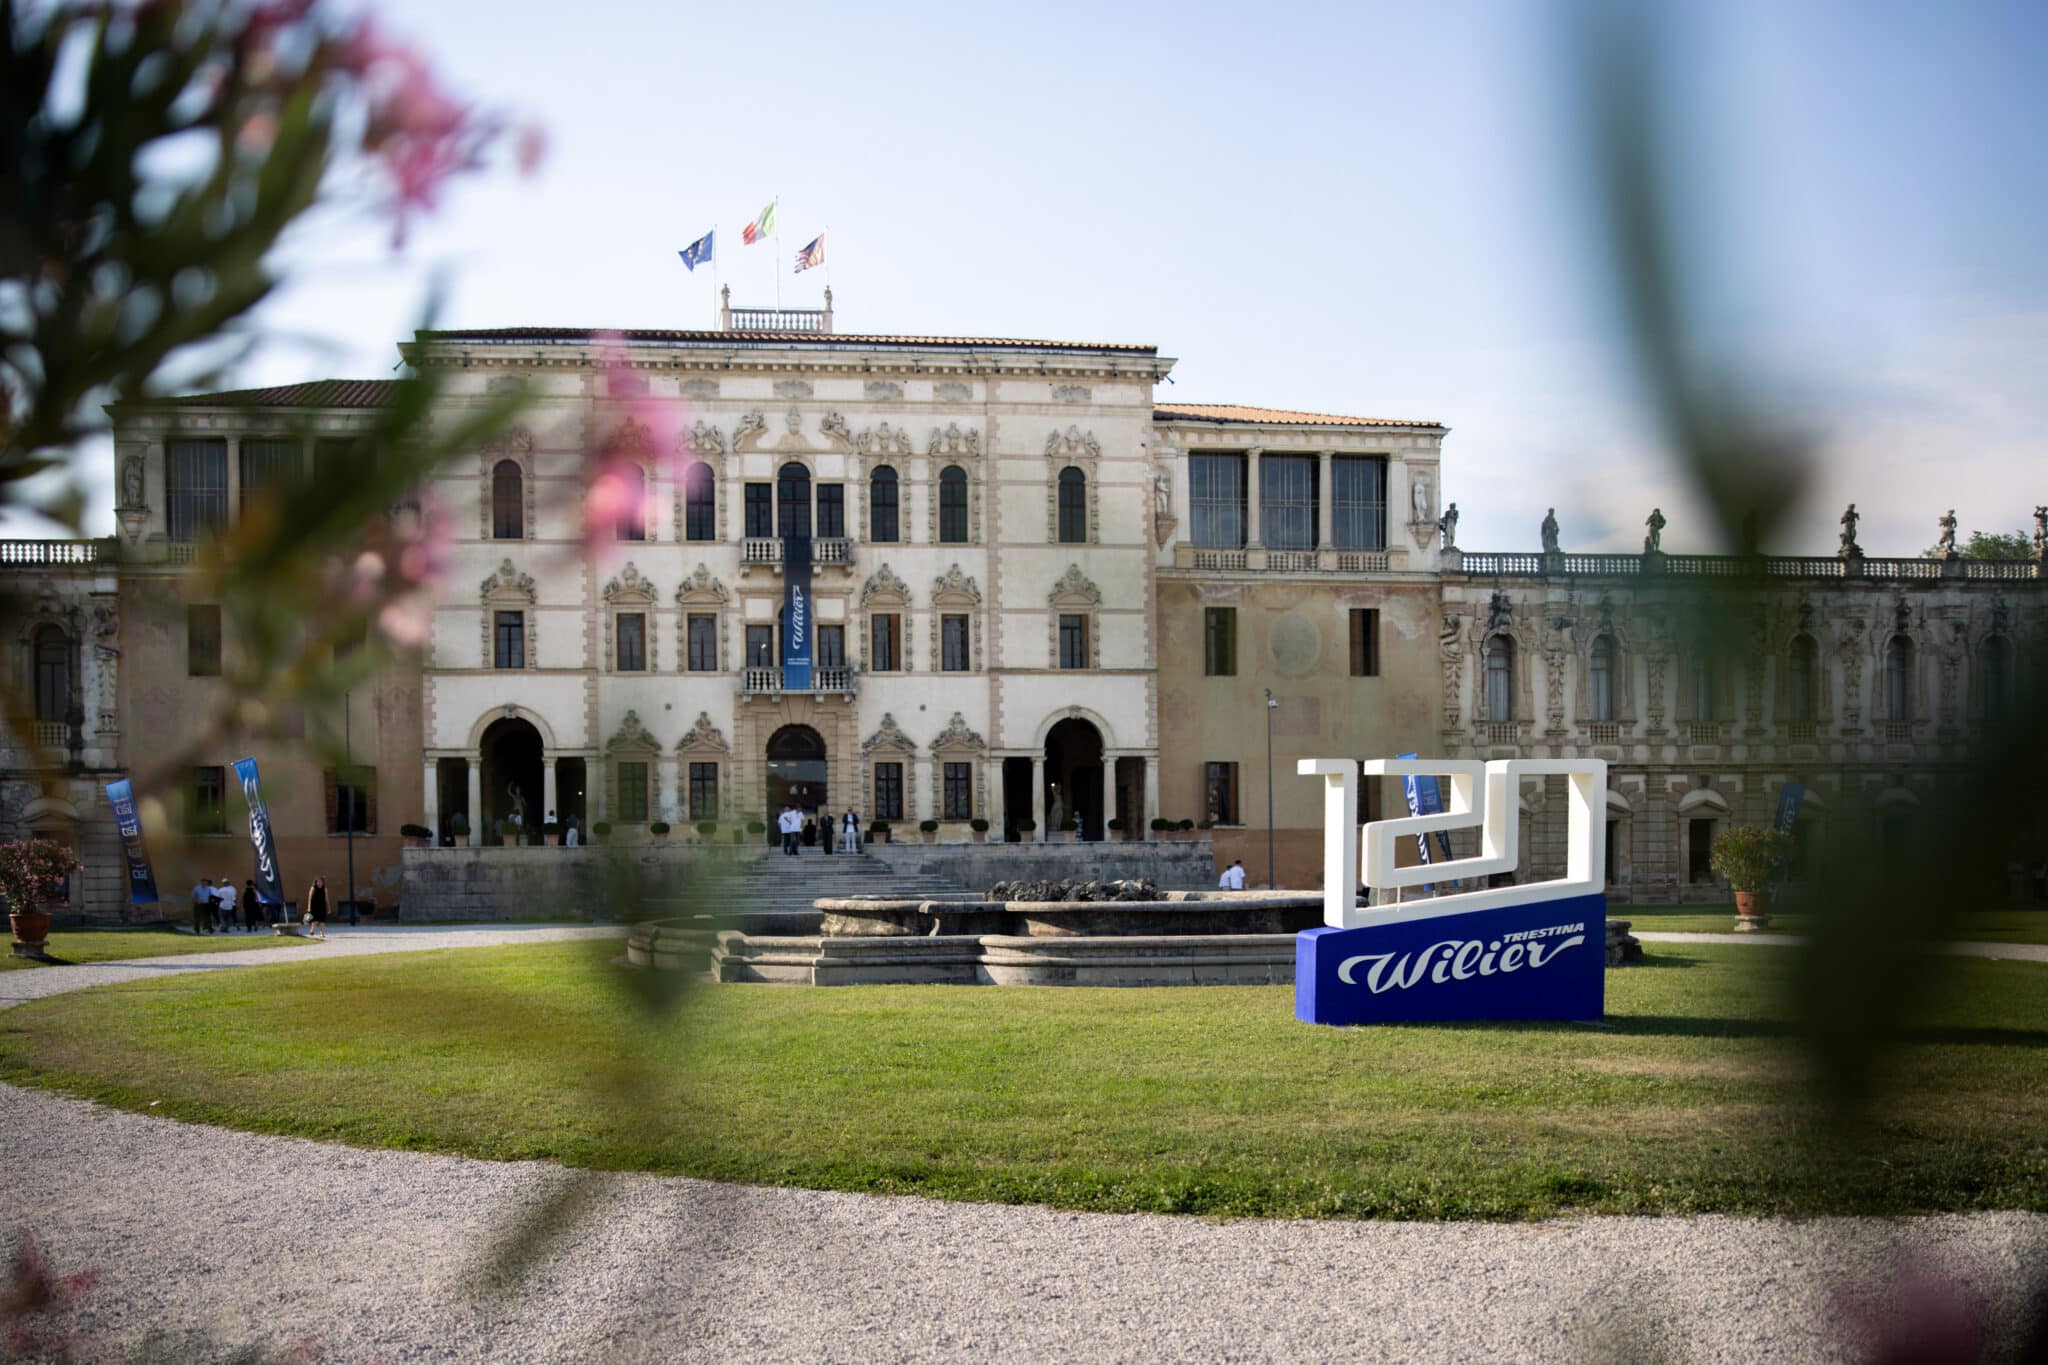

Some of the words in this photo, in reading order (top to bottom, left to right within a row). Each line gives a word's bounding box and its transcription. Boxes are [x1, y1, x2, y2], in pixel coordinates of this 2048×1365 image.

[793, 585, 804, 650] Wilier
[1503, 922, 1585, 943] TRIESTINA
[1338, 935, 1585, 995] Wilier
